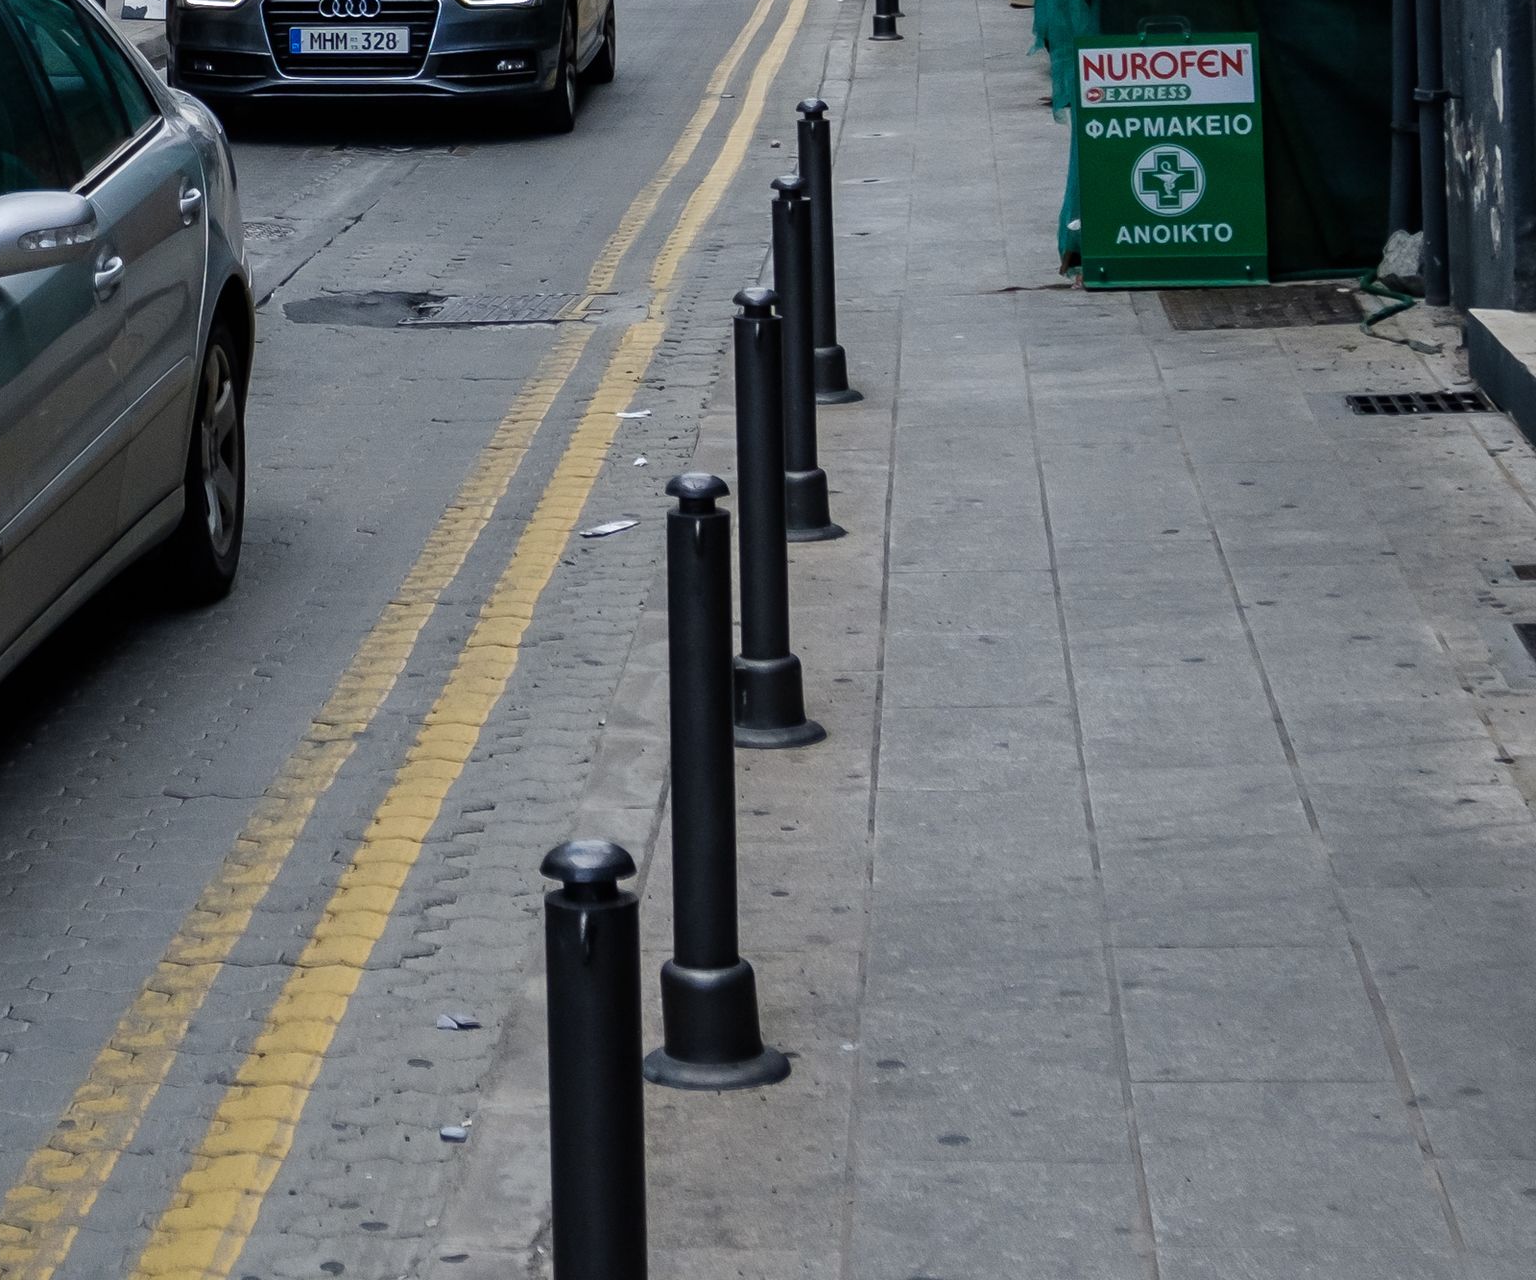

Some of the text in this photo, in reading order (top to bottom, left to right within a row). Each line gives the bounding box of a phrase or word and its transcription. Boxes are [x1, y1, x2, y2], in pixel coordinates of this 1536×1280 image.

[310, 32, 348, 50] MHM
[361, 32, 397, 50] 328
[1082, 49, 1244, 81] NUROFEN
[1106, 85, 1188, 101] EXPRESS
[1085, 114, 1253, 139] ΦΑΡΜΑΚΕΙΟ
[1116, 223, 1233, 244] ΑΝΟΙΚΤΟ
